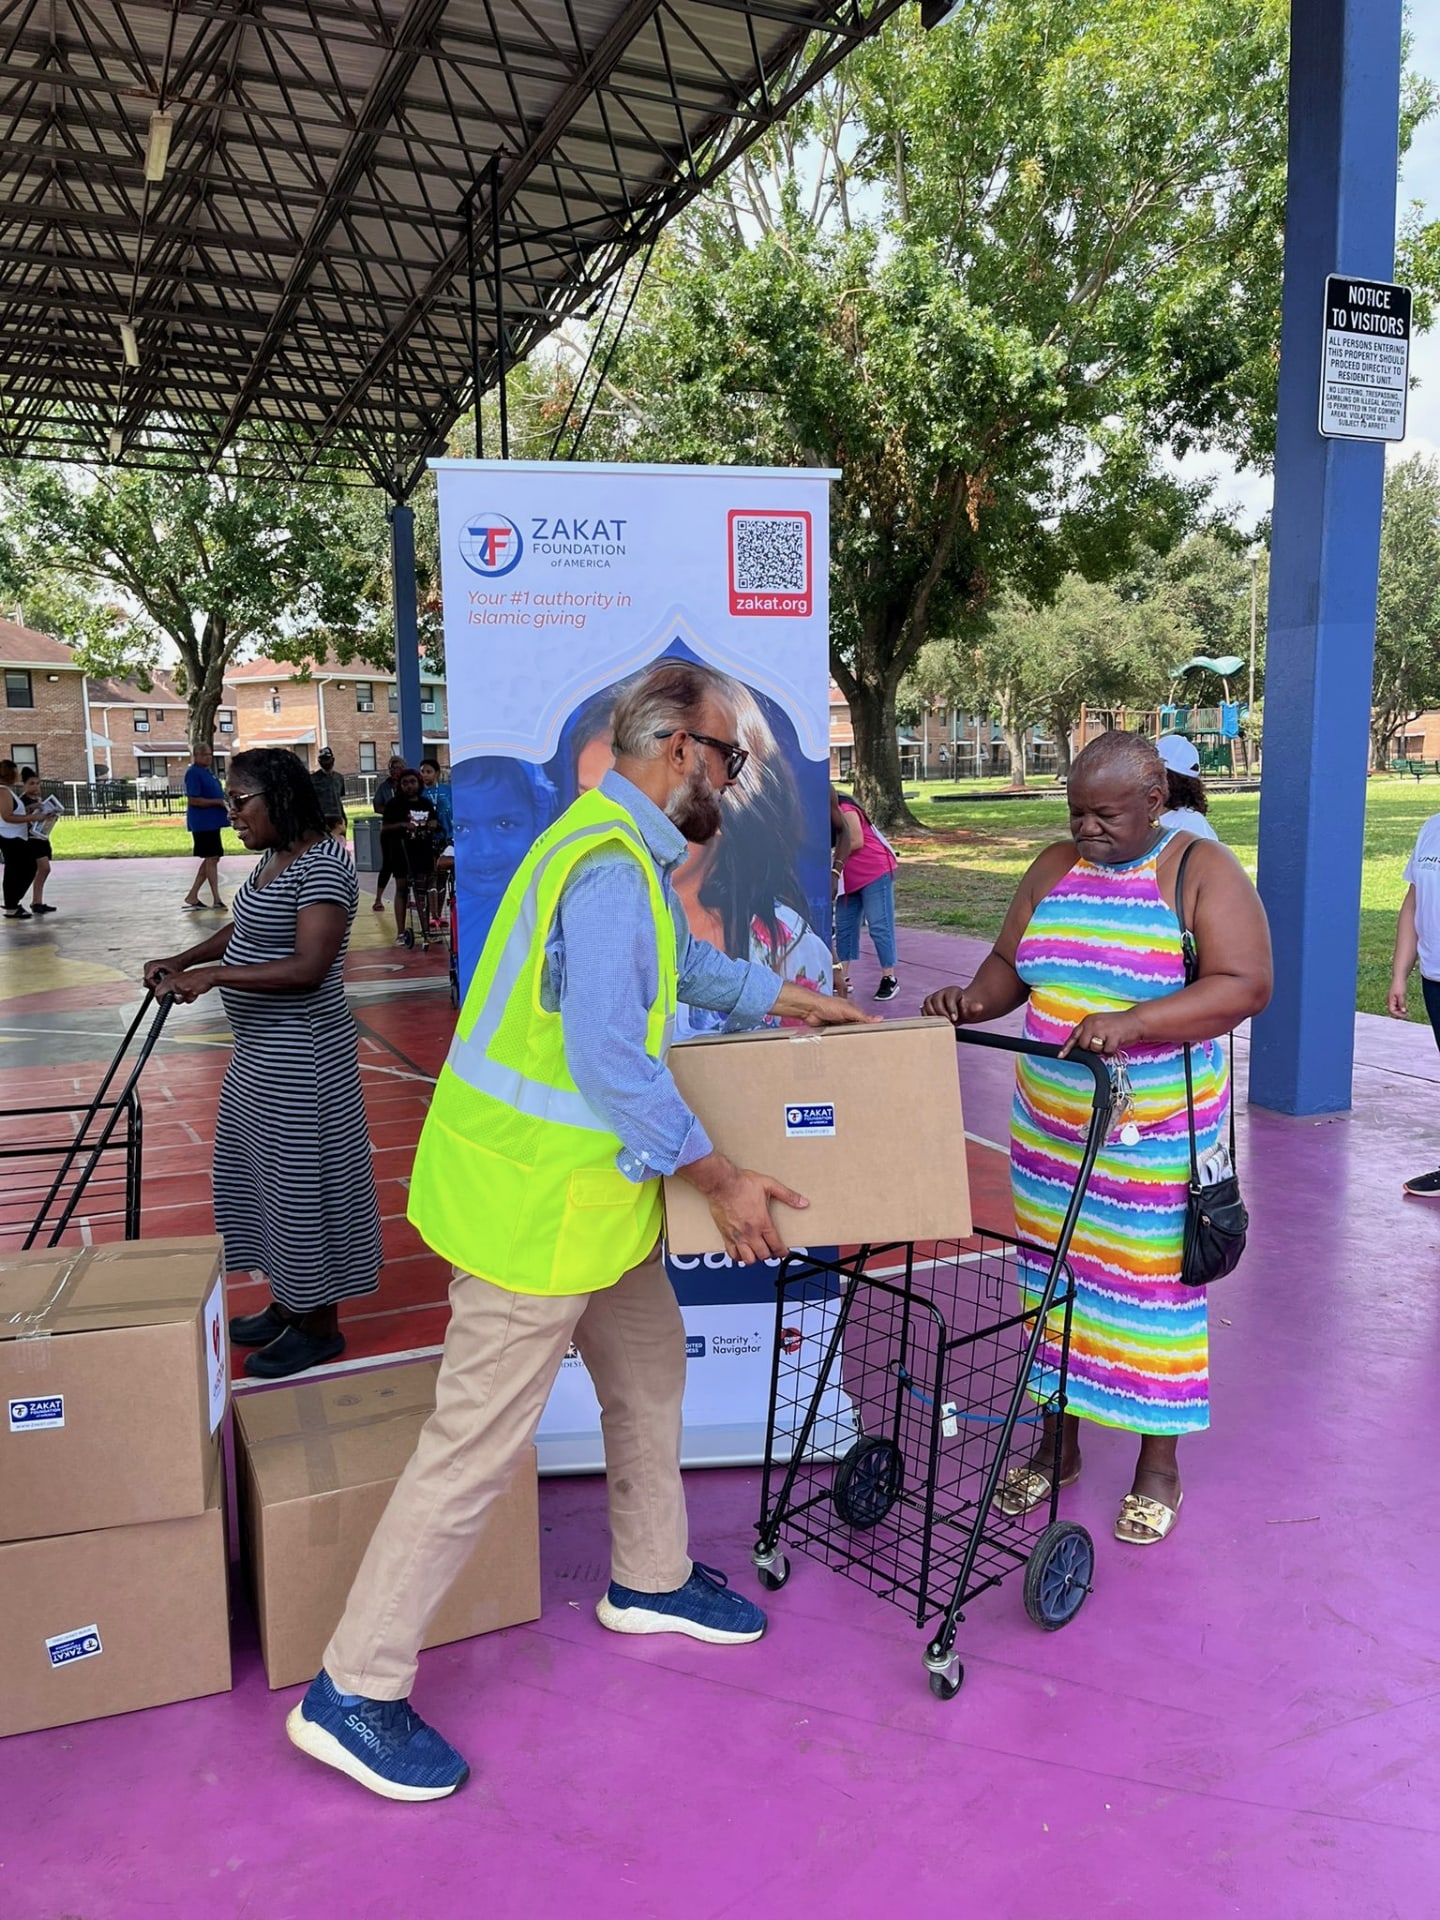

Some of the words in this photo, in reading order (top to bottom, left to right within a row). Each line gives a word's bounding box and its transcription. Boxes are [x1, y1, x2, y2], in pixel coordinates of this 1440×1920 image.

[1348, 285, 1391, 309] NOTICE
[1332, 308, 1346, 327] TO
[1350, 310, 1404, 336] VISITORS
[1329, 336, 1341, 346] ALL
[1342, 338, 1372, 350] PERSONS
[1374, 342, 1405, 354] ENTERING
[1328, 347, 1343, 357] THIS
[1344, 350, 1378, 361] PROPERTY
[1379, 353, 1405, 365] SHOULD
[1331, 359, 1360, 370] PROCEED
[1362, 362, 1391, 374] DIRECTLY
[1393, 366, 1401, 376] TO
[1338, 370, 1375, 383] RESIDENT'S
[531, 518, 628, 541] ZAKAT
[532, 543, 626, 556] FOUNDATION
[551, 559, 562, 568] of
[563, 559, 611, 569] AMERICA
[467, 590, 507, 606] Your
[510, 591, 529, 605] #1
[533, 591, 614, 611] authority
[616, 591, 632, 607] in
[736, 595, 807, 614] zakat.org
[467, 609, 531, 625] Islamic
[533, 609, 586, 629] giving
[803, 1109, 832, 1117] ZAKAT
[712, 1335, 749, 1346] Charity
[712, 1345, 761, 1356] Navigator
[30, 1401, 61, 1411] ZAKAT
[53, 1646, 83, 1662] ZAKAT
[344, 1714, 393, 1760] SPRINT
